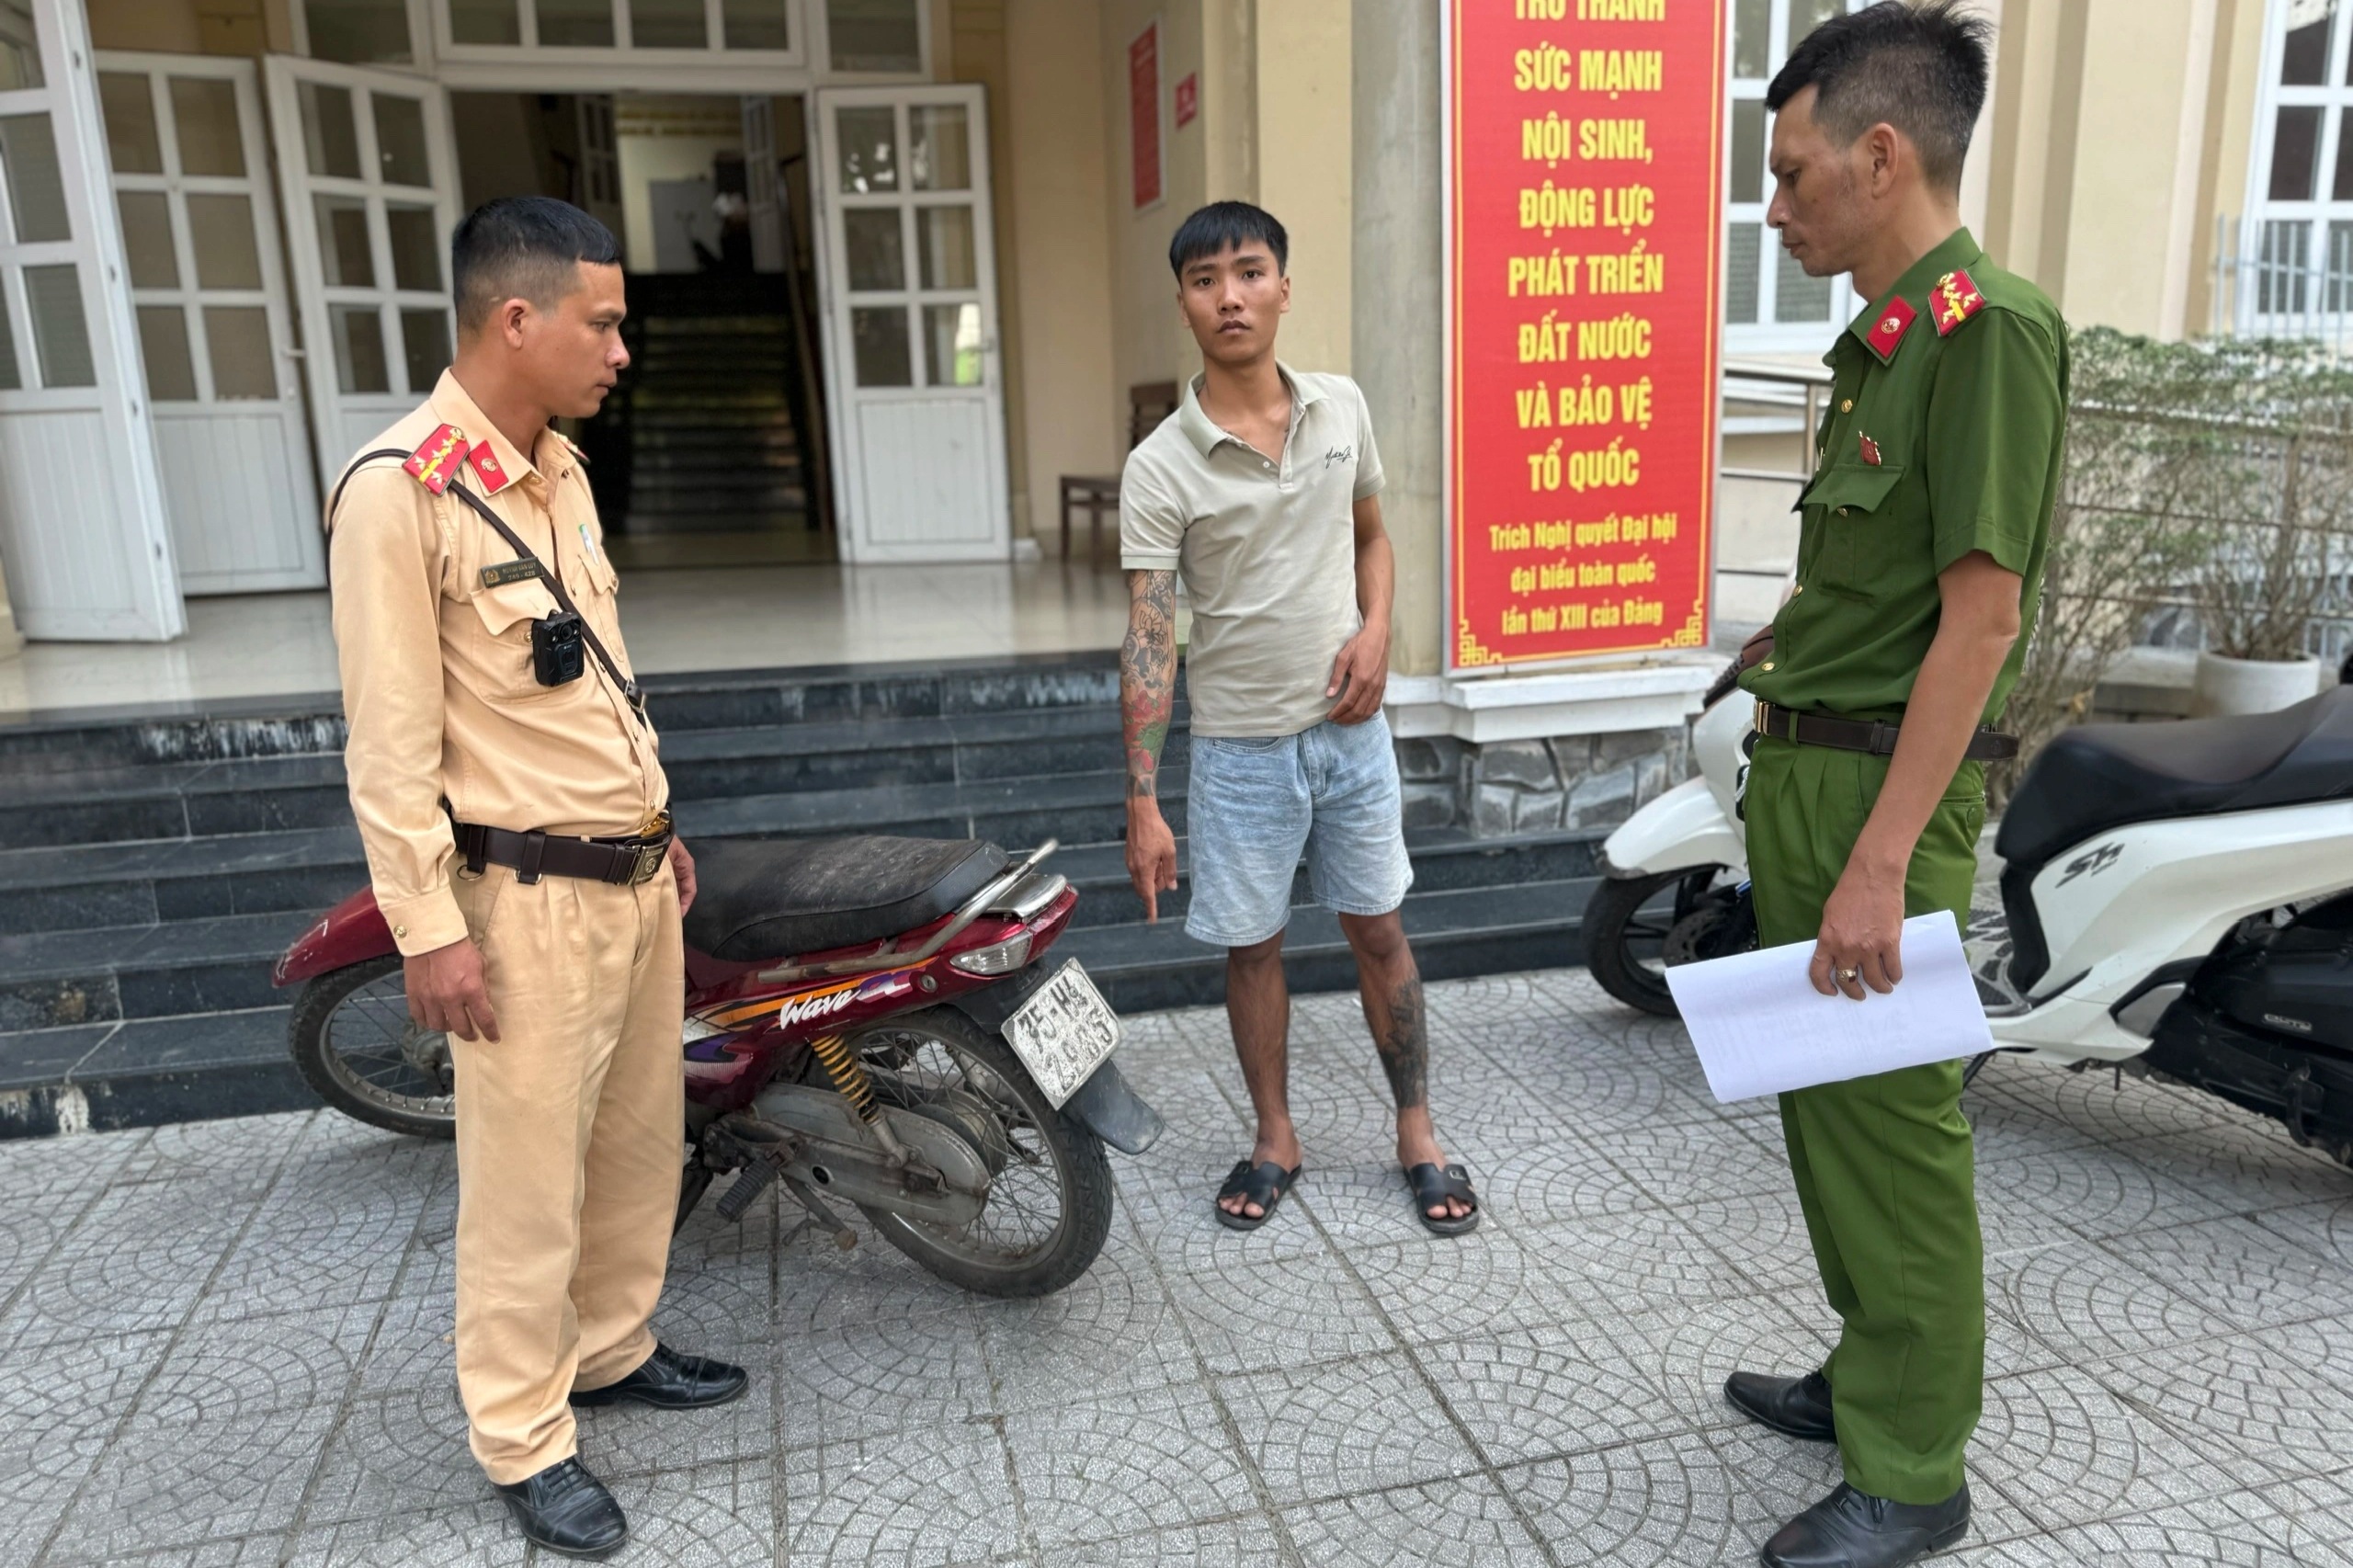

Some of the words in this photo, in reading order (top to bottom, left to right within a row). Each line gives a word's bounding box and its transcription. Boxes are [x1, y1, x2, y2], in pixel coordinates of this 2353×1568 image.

[1514, 40, 1572, 92] SỨC
[1579, 49, 1664, 100] MẠNH
[1521, 109, 1572, 169] NỘI
[1578, 118, 1654, 165] SINH,
[1518, 179, 1597, 238] ĐỘNG
[1603, 183, 1654, 236] LỰC
[1508, 247, 1580, 297] PHÁT
[1586, 238, 1665, 294] TRIỂN
[1518, 309, 1572, 363] ĐẤT
[1578, 312, 1653, 360] NƯỚC
[1516, 381, 1552, 428] VÀ
[1559, 373, 1614, 426] BẢO
[1620, 375, 1654, 430] VỆ
[1528, 437, 1563, 492] TỔ
[1568, 435, 1640, 494] QUỐC
[1489, 522, 1531, 551] Trích
[1534, 519, 1572, 551] Nghị
[1574, 512, 1620, 548] quyết
[1621, 514, 1649, 546] Đại
[1652, 512, 1677, 544] hội
[1510, 565, 1537, 597] đại
[1540, 556, 1575, 590] biểu
[1578, 559, 1614, 587] toàn
[1617, 552, 1656, 587] quốc
[1530, 605, 1557, 633] thứ
[1560, 602, 1588, 631] XIII
[1590, 597, 1620, 629] của
[1623, 595, 1664, 626] Đảng
[2055, 842, 2125, 889] SH
[779, 989, 862, 1030] Wave
